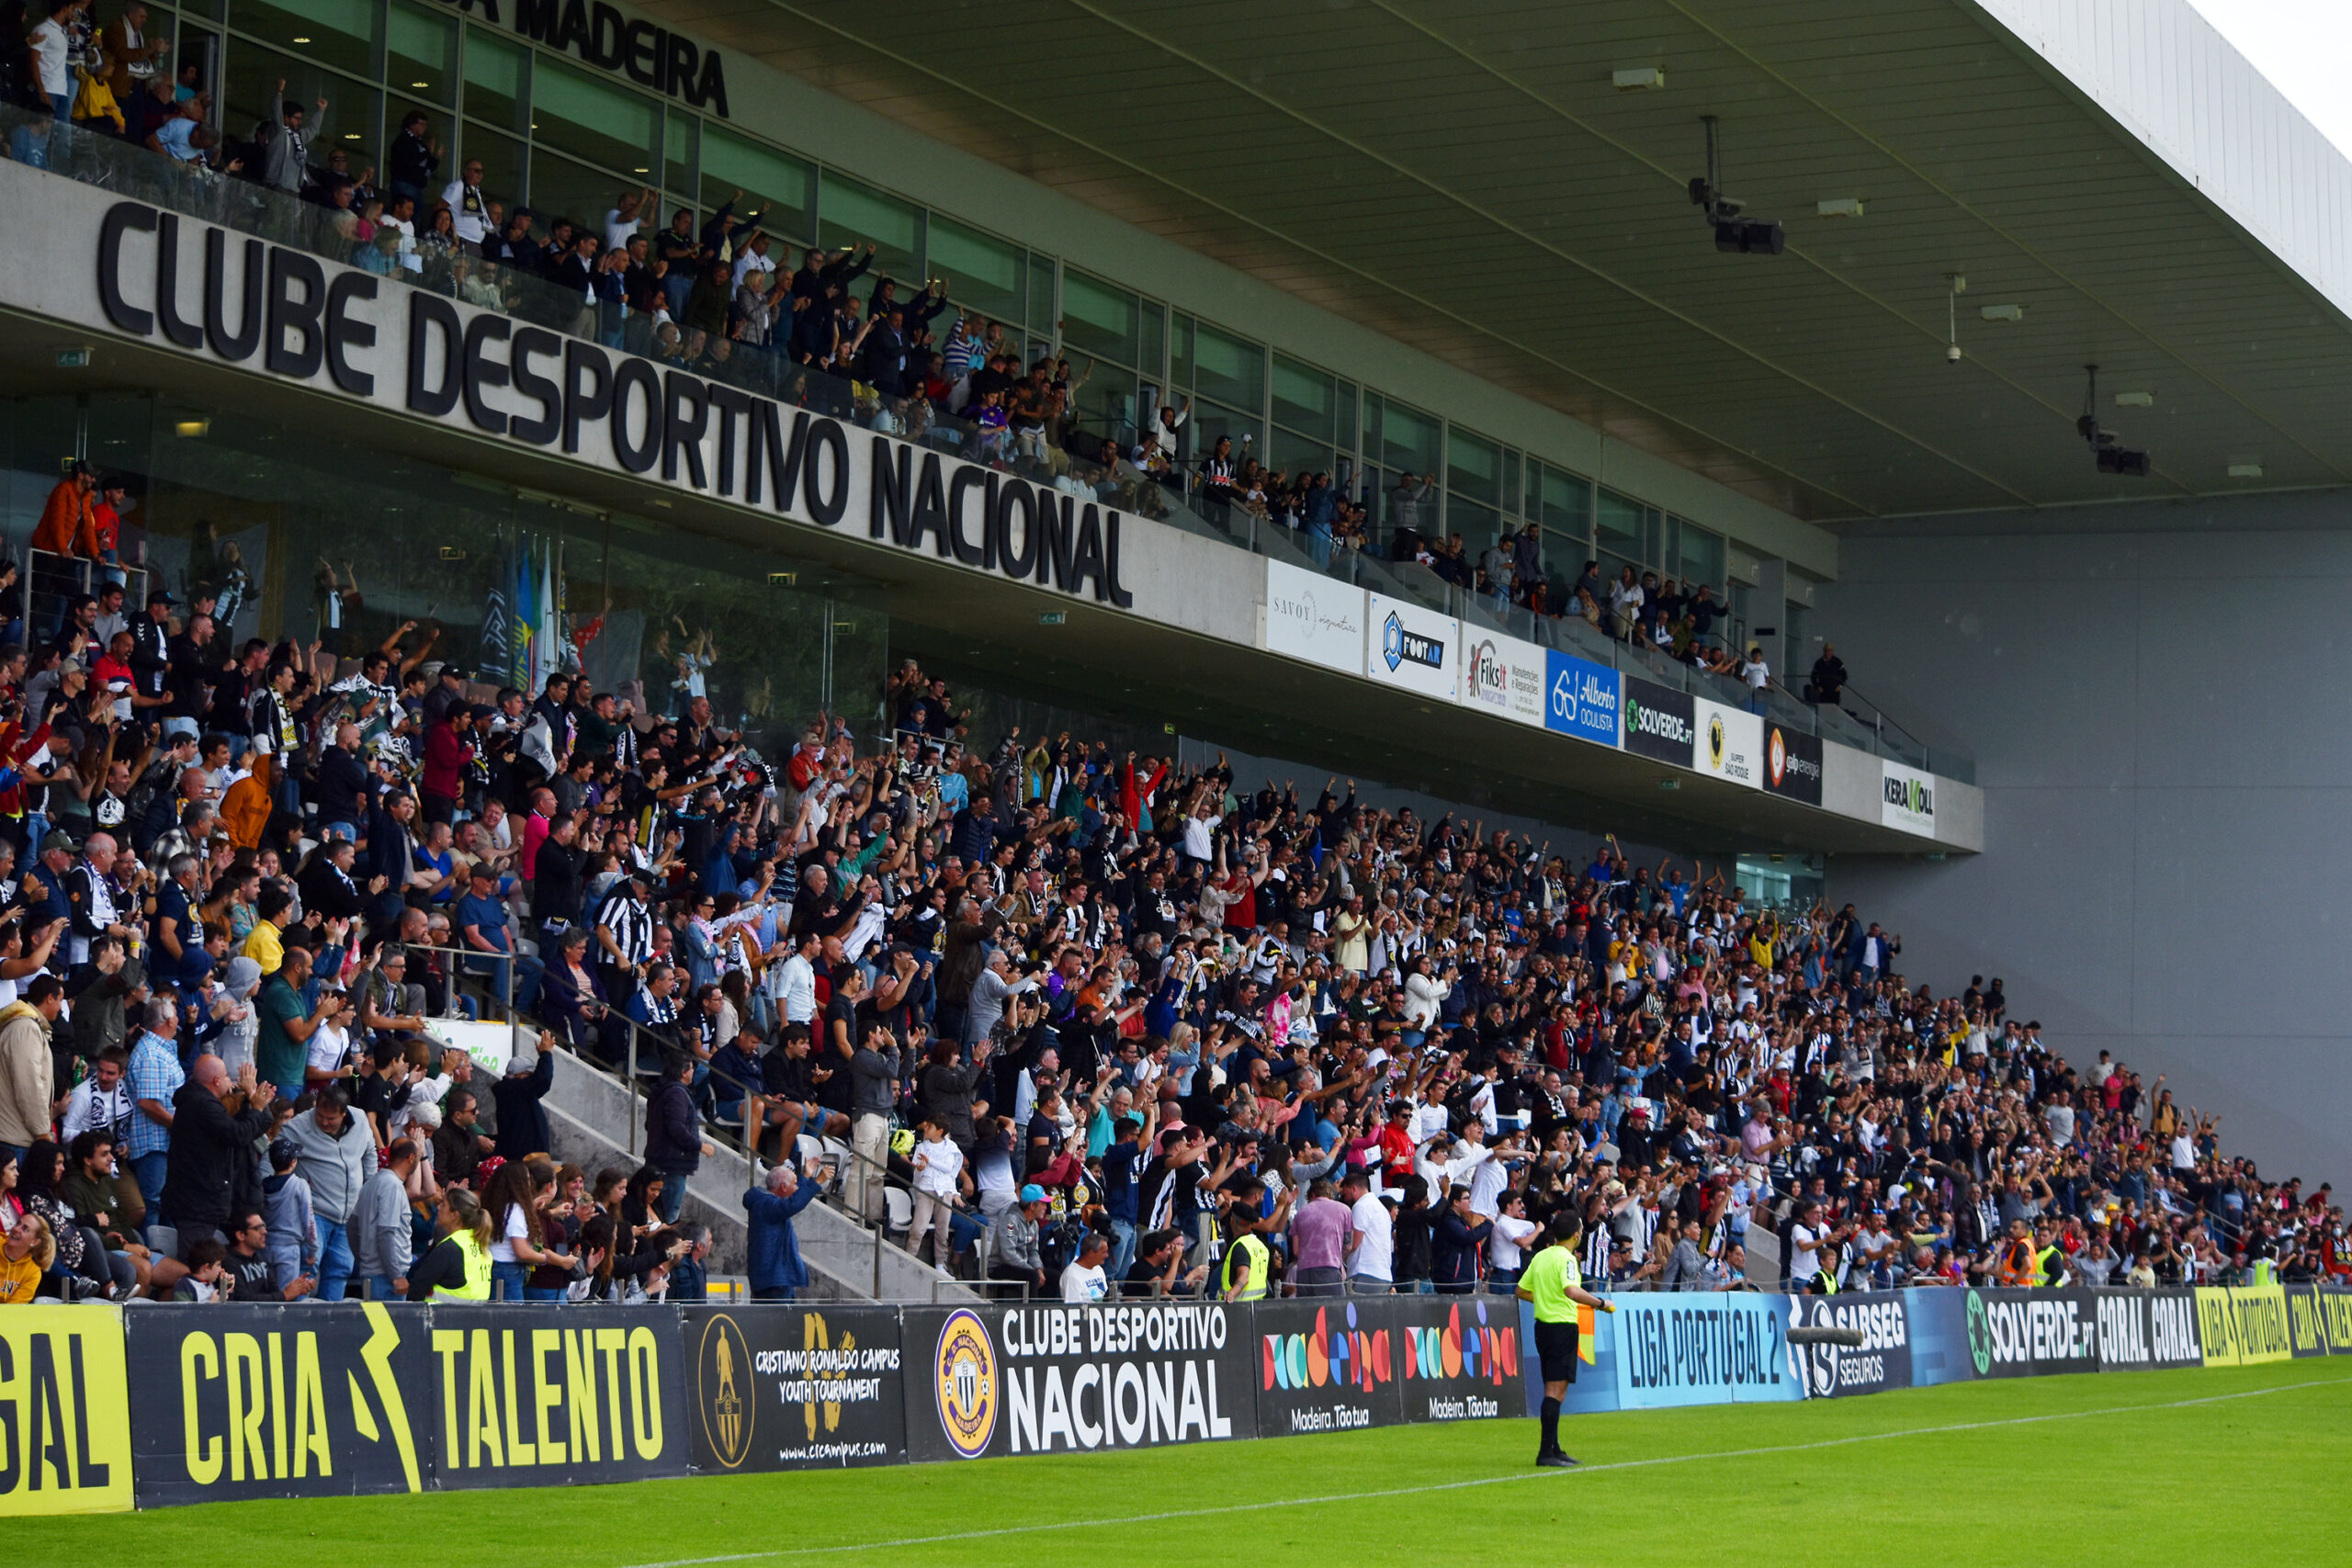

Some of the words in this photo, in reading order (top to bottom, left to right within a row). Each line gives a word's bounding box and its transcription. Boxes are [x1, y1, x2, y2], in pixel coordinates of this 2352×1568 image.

[100, 202, 378, 396] CLUBE
[407, 291, 850, 525] DESPORTIVO
[871, 436, 1133, 608] NACIONAL
[1273, 597, 1311, 621] SAVOY
[1318, 615, 1358, 634] signature
[1403, 637, 1441, 664] FOOTAR
[1480, 657, 1507, 691] Fiks!t
[1580, 674, 1615, 710] Alberto
[1580, 707, 1613, 732] OCULISTA
[1638, 706, 1693, 745] SOLVERDE.PT
[1785, 753, 1799, 775] galp
[1799, 758, 1819, 780] energia
[1884, 776, 1933, 816] KERAKOLL
[1002, 1309, 1082, 1357] CLUBE
[1089, 1305, 1227, 1353] DESPORTIVO
[1836, 1301, 1905, 1353] SABSEG
[1987, 1301, 2095, 1363] SOLVERDE.PT
[2098, 1295, 2149, 1364] CORAL
[2152, 1296, 2200, 1362] CORAL
[2200, 1298, 2229, 1358] LIGA
[2237, 1296, 2289, 1356] PORTUGAL
[2291, 1294, 2317, 1350] CRIA
[755, 1350, 808, 1374] CRISTIANO
[809, 1349, 859, 1373] RONALDO
[861, 1348, 900, 1372] CAMPUS
[958, 1336, 985, 1371] NACIONAL
[1625, 1308, 1670, 1388] LIGA
[1671, 1308, 1766, 1386] PORTUGAL
[1768, 1309, 1780, 1384] 2
[1840, 1355, 1883, 1386] SEGUROS
[181, 1331, 333, 1484] CRIA
[432, 1325, 664, 1469] TALENTO
[779, 1380, 811, 1404] YOUTH
[814, 1378, 880, 1403] TOURNAMENT
[1007, 1359, 1232, 1452] NACIONAL
[956, 1414, 982, 1432] MADEIRA
[779, 1441, 887, 1467] www.crcampus.com
